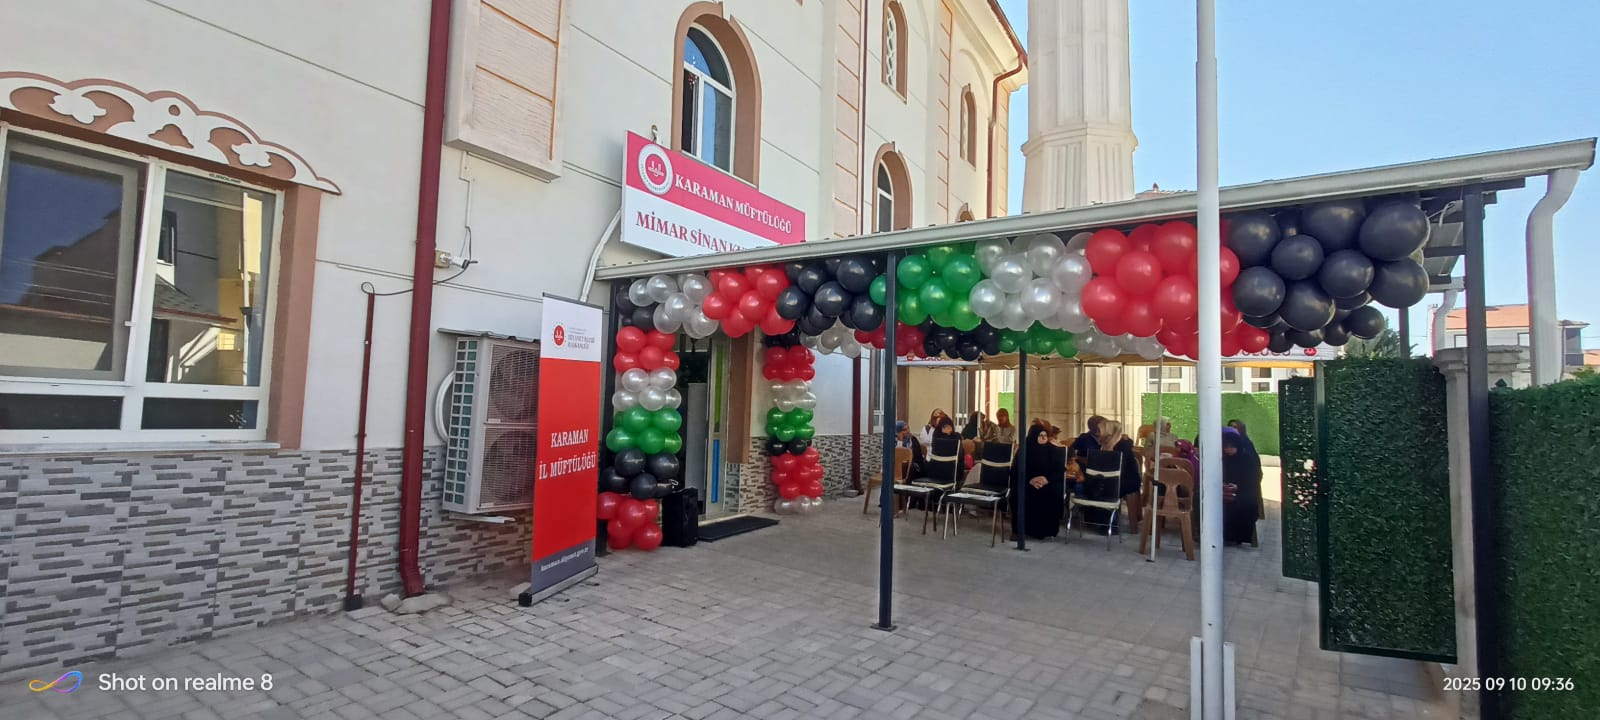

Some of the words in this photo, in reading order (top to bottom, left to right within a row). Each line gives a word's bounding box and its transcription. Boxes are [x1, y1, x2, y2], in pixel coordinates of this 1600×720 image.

[675, 174, 734, 211] KARAMAN
[735, 202, 793, 235] MÜFTÜLÜĞÜ
[636, 211, 688, 241] MİMAR
[690, 229, 728, 253] SİNAN
[551, 429, 589, 448] KARAMAN
[539, 460, 548, 480] İL
[550, 451, 597, 478] MÜFTÜLÜĞÜ
